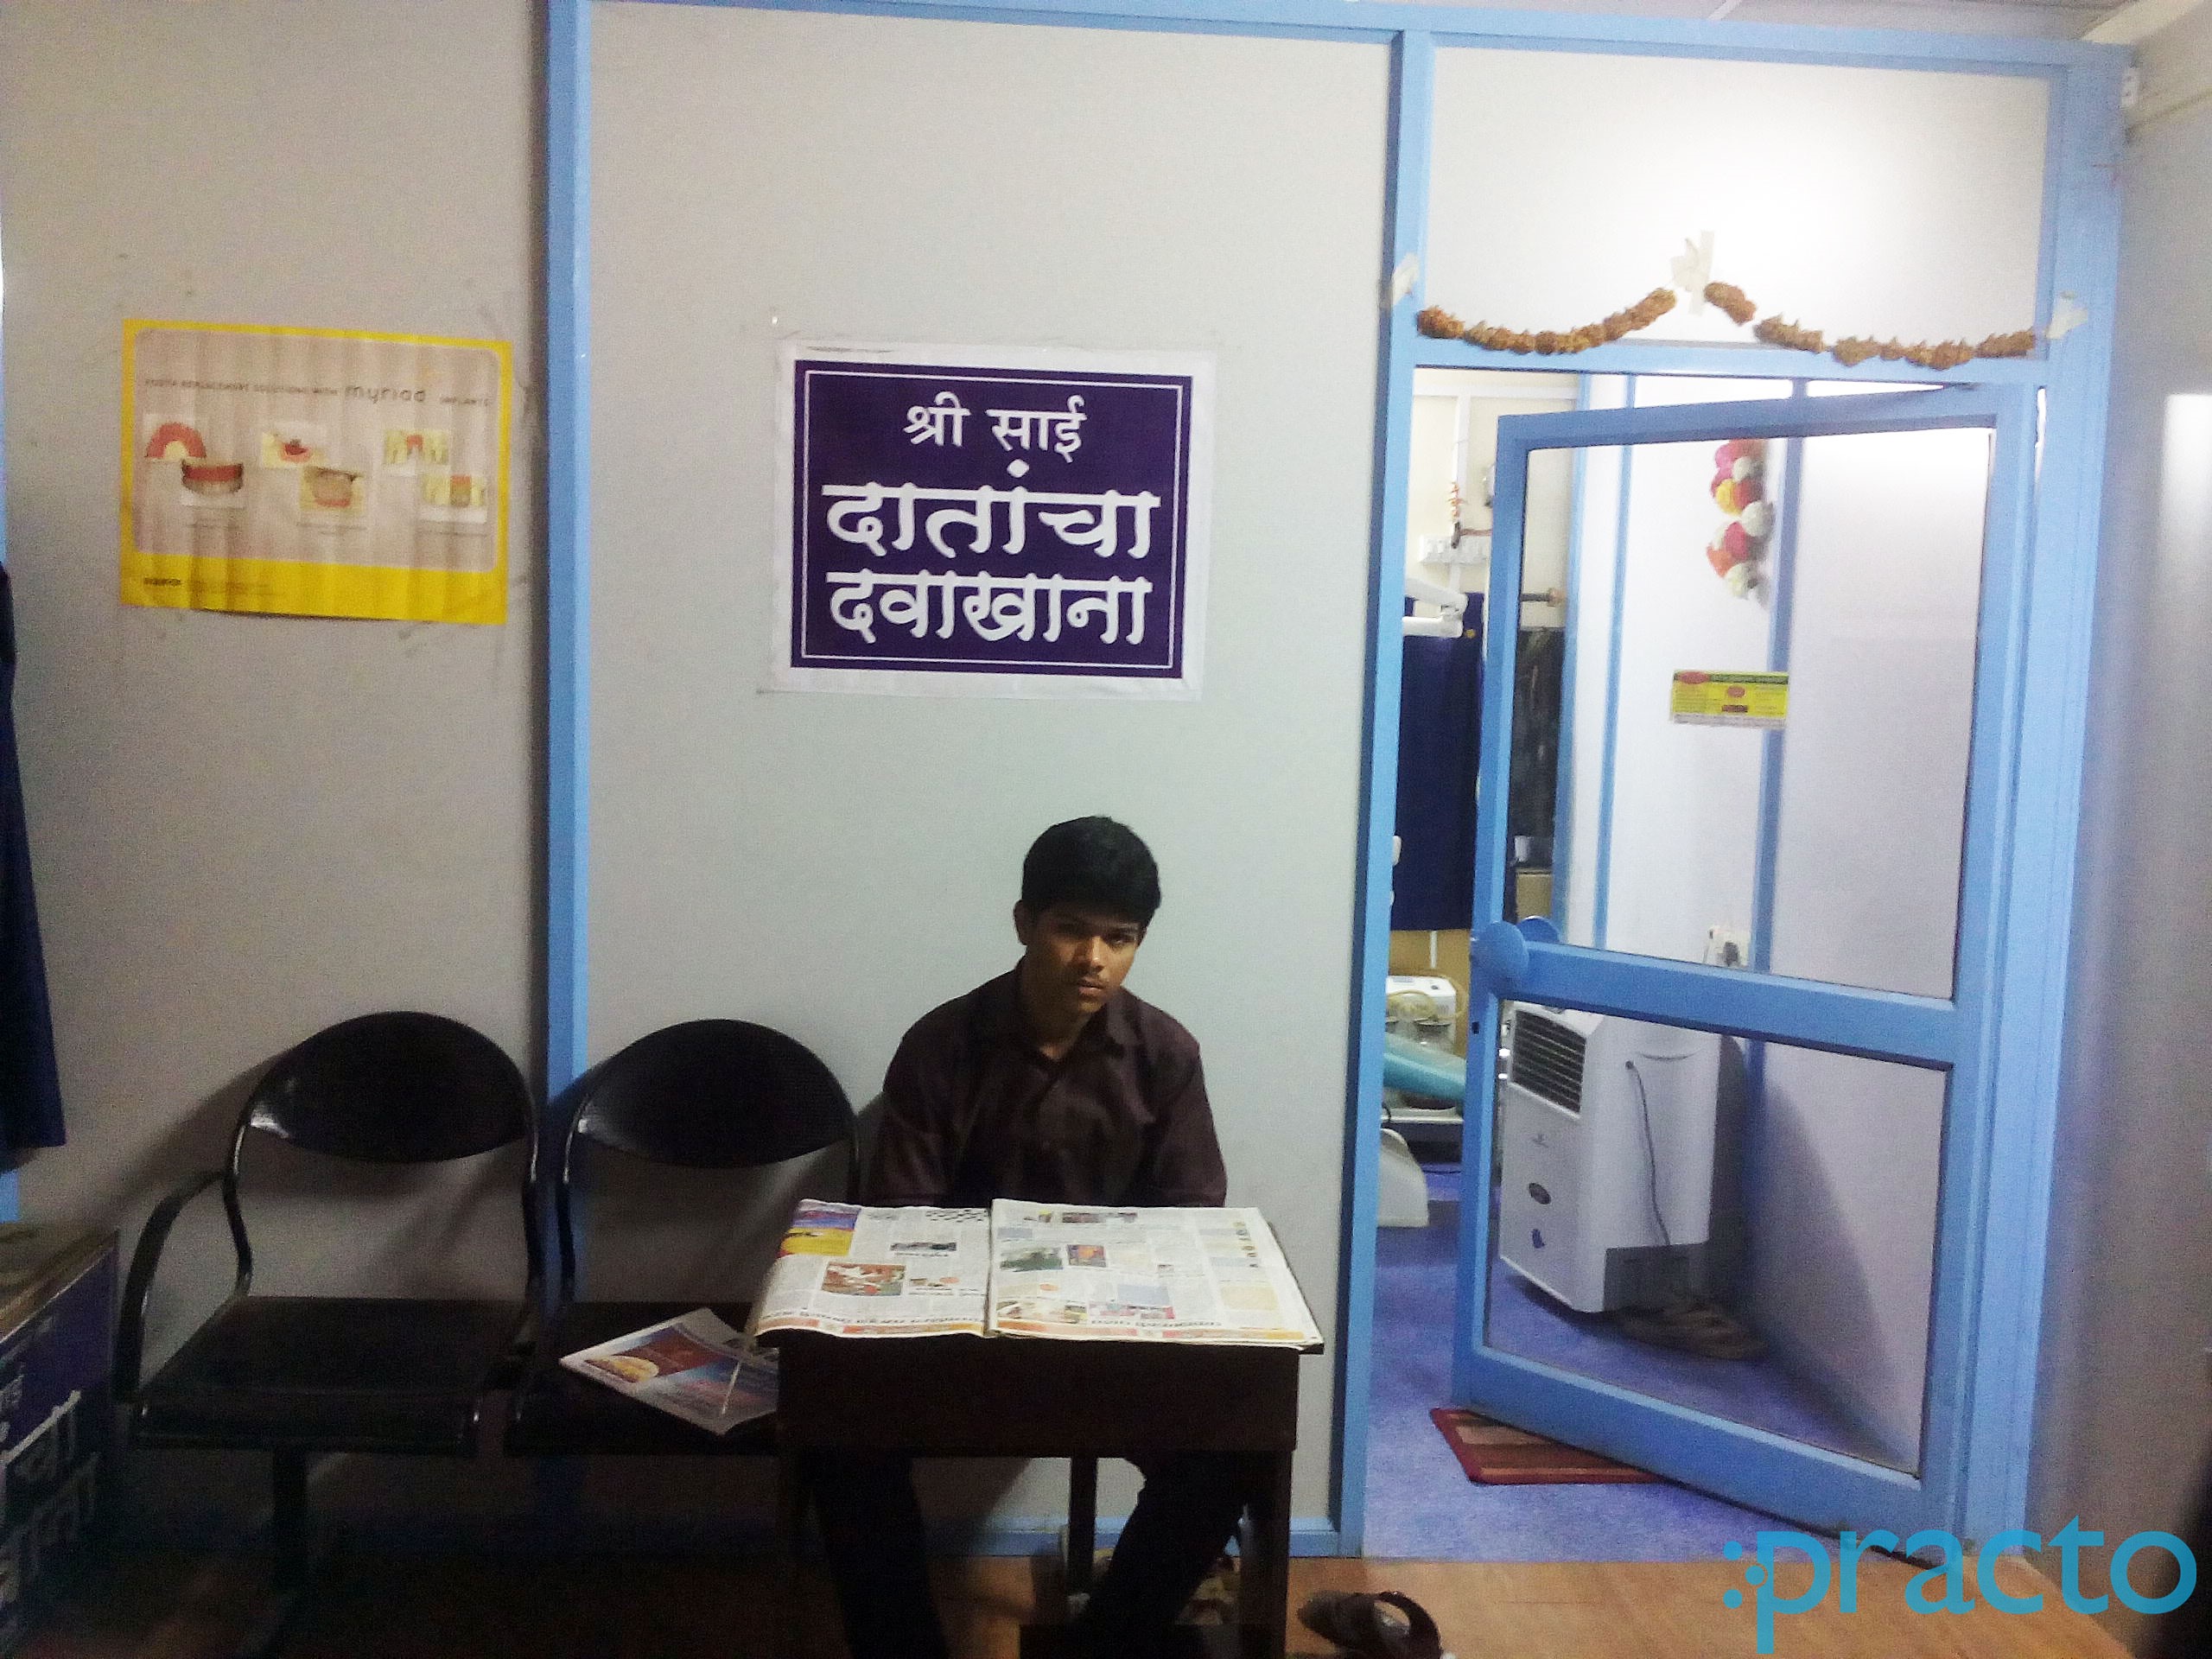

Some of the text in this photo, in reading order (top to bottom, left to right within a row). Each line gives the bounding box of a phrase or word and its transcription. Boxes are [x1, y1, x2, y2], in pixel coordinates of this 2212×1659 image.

[904, 391, 1087, 462] श्री साई
[823, 460, 1160, 558] दातांचा
[827, 569, 1153, 645] दवाखाना
